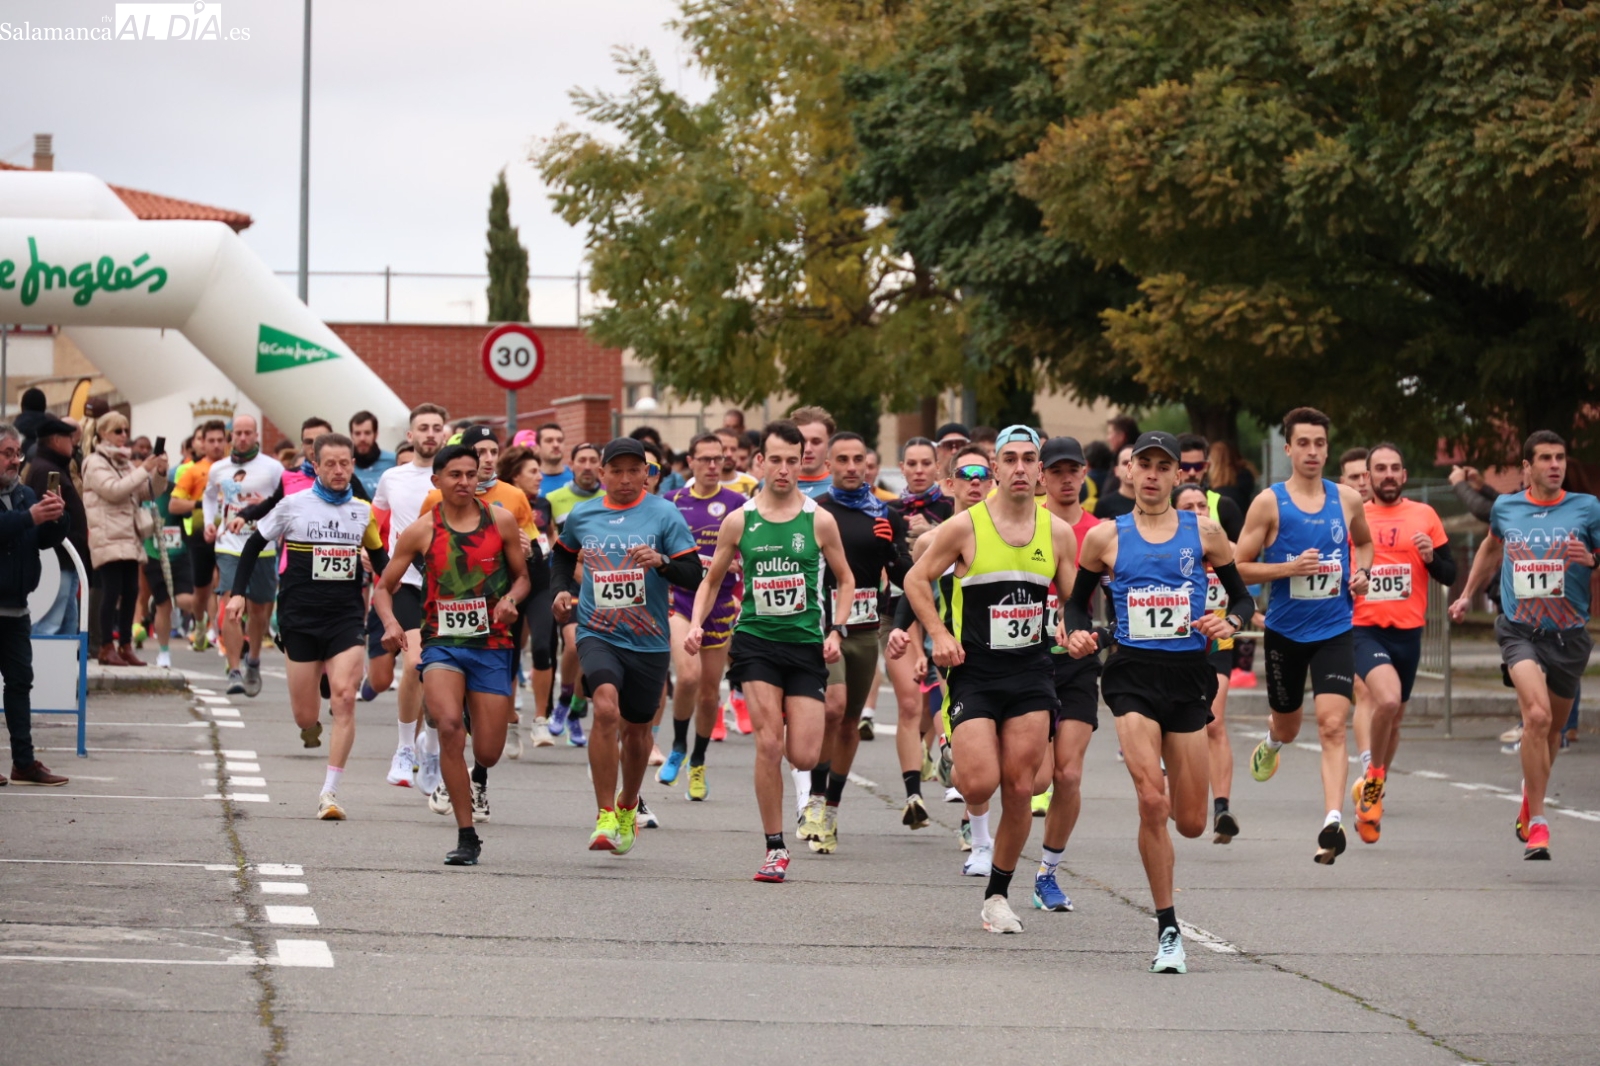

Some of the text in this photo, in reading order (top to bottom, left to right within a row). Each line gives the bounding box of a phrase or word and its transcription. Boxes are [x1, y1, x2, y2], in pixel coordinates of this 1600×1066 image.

[20, 236, 168, 307] Inglés
[497, 346, 530, 368] 30
[321, 557, 351, 572] 753
[756, 557, 800, 575] gullón
[1318, 562, 1341, 574] unia
[1371, 566, 1410, 577] edunia
[1514, 562, 1562, 573] bedunia
[594, 572, 643, 583] bedunia
[754, 577, 804, 590] bedunia
[1307, 574, 1328, 590] 17
[1372, 577, 1404, 593] 305
[1527, 573, 1547, 589] 11
[601, 582, 637, 600] 450
[763, 588, 798, 607] 157
[438, 600, 486, 611] bedunia
[1128, 594, 1189, 607] bedunia
[445, 611, 480, 628] 598
[991, 605, 1043, 619] bedunia
[1145, 607, 1174, 628] 12
[1007, 619, 1031, 638] 36
